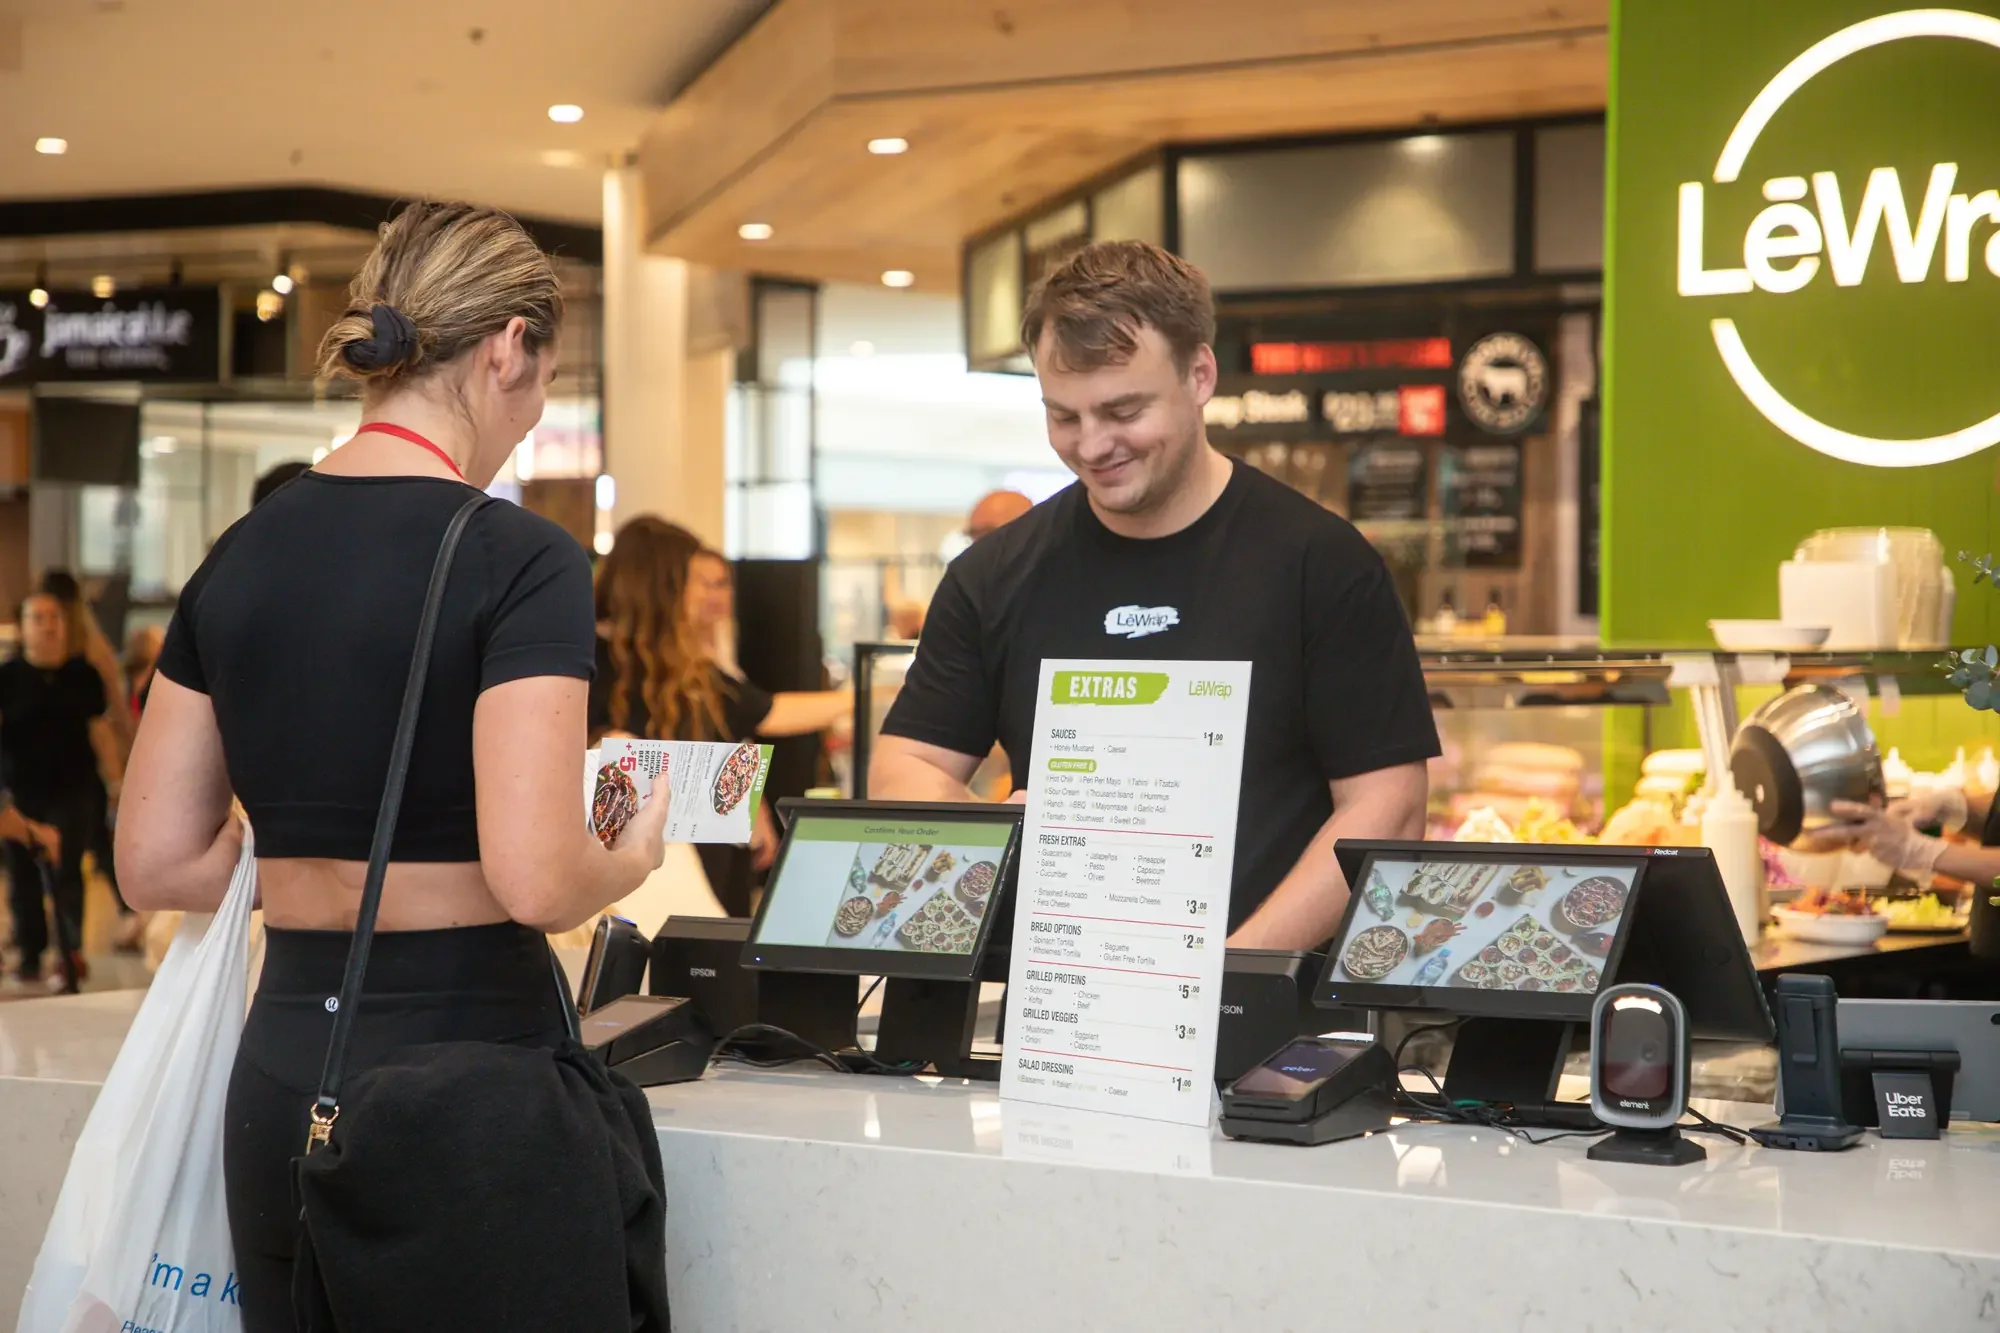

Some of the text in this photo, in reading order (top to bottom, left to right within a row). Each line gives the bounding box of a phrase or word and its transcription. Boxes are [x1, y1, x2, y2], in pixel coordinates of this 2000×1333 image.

[1677, 162, 2000, 297] LēWr
[1069, 675, 1138, 699] EXTRAS
[1051, 728, 1077, 739] SAUCES
[1053, 743, 1095, 752] Honey Mustard
[643, 751, 651, 772] KOFTA
[648, 751, 656, 780] CHICKEN
[654, 751, 662, 778] SCHNIT
[661, 752, 670, 772] ADD
[1049, 775, 1060, 783] Hot
[1106, 777, 1121, 786] Mayo
[1159, 779, 1180, 788] Tzatziki
[1048, 787, 1080, 796] Sour Cream
[1090, 789, 1116, 798] Thousand
[1144, 792, 1170, 801] Hummus
[1047, 800, 1064, 808] Ranch
[1073, 801, 1086, 809] BBQ
[1095, 802, 1128, 811] Mayonnaise
[1137, 804, 1154, 813] Garlic
[1046, 812, 1067, 821] Tomato
[1076, 814, 1105, 823] Southwest
[1113, 816, 1131, 825] Sweet
[864, 826, 896, 834] Confirm
[916, 827, 940, 836] Order
[1039, 834, 1087, 847] FRESH EXTRAS
[1191, 843, 1213, 858] $2.00
[1654, 848, 1679, 856] Redcat
[1041, 858, 1056, 867] Salsa
[1137, 855, 1166, 864] Pineapple
[1089, 862, 1105, 871] Pesto
[1136, 865, 1165, 875] Capsicum
[1040, 868, 1068, 878] Cucumber
[1088, 872, 1105, 881] Olives
[1135, 876, 1161, 885] Beetroot
[1038, 887, 1088, 899] Smashed Avocado
[1037, 898, 1071, 908] Feta Cheese
[1139, 895, 1161, 905] Cheese
[1186, 899, 1208, 914] $3.00
[1030, 921, 1082, 936] BREAD OPTIONS
[1033, 935, 1056, 945] Spinach
[1183, 934, 1205, 949] $2.00
[1104, 942, 1130, 952] Baguette
[1103, 952, 1156, 965] Gluten Free Tortilla
[690, 967, 716, 977] EPSON
[1026, 970, 1086, 986] GRILLED PROTEINS
[1029, 984, 1053, 995] Schnitzel
[1078, 990, 1101, 999] Chicken
[1178, 984, 1200, 999] $5.00
[1028, 995, 1043, 1005] Kofta
[1077, 1000, 1090, 1009] Beef
[1219, 1004, 1244, 1015] PSON
[1022, 1007, 1079, 1024] GRILLED VEGGIES
[1025, 1025, 1054, 1035] Mushroom
[1174, 1024, 1196, 1040] $3.00
[1024, 1034, 1041, 1044] Onion
[1074, 1030, 1099, 1041] Eggplant
[1073, 1040, 1101, 1051] Capsicum
[1018, 1058, 1074, 1075] SALAD DRESSING
[1172, 1076, 1192, 1092] $1.00
[1108, 1086, 1129, 1096] Caesar
[1885, 1092, 1923, 1105] Uber
[1619, 1099, 1650, 1110] element
[1887, 1104, 1927, 1118] Eats
[152, 1253, 242, 1307] 'm a k
